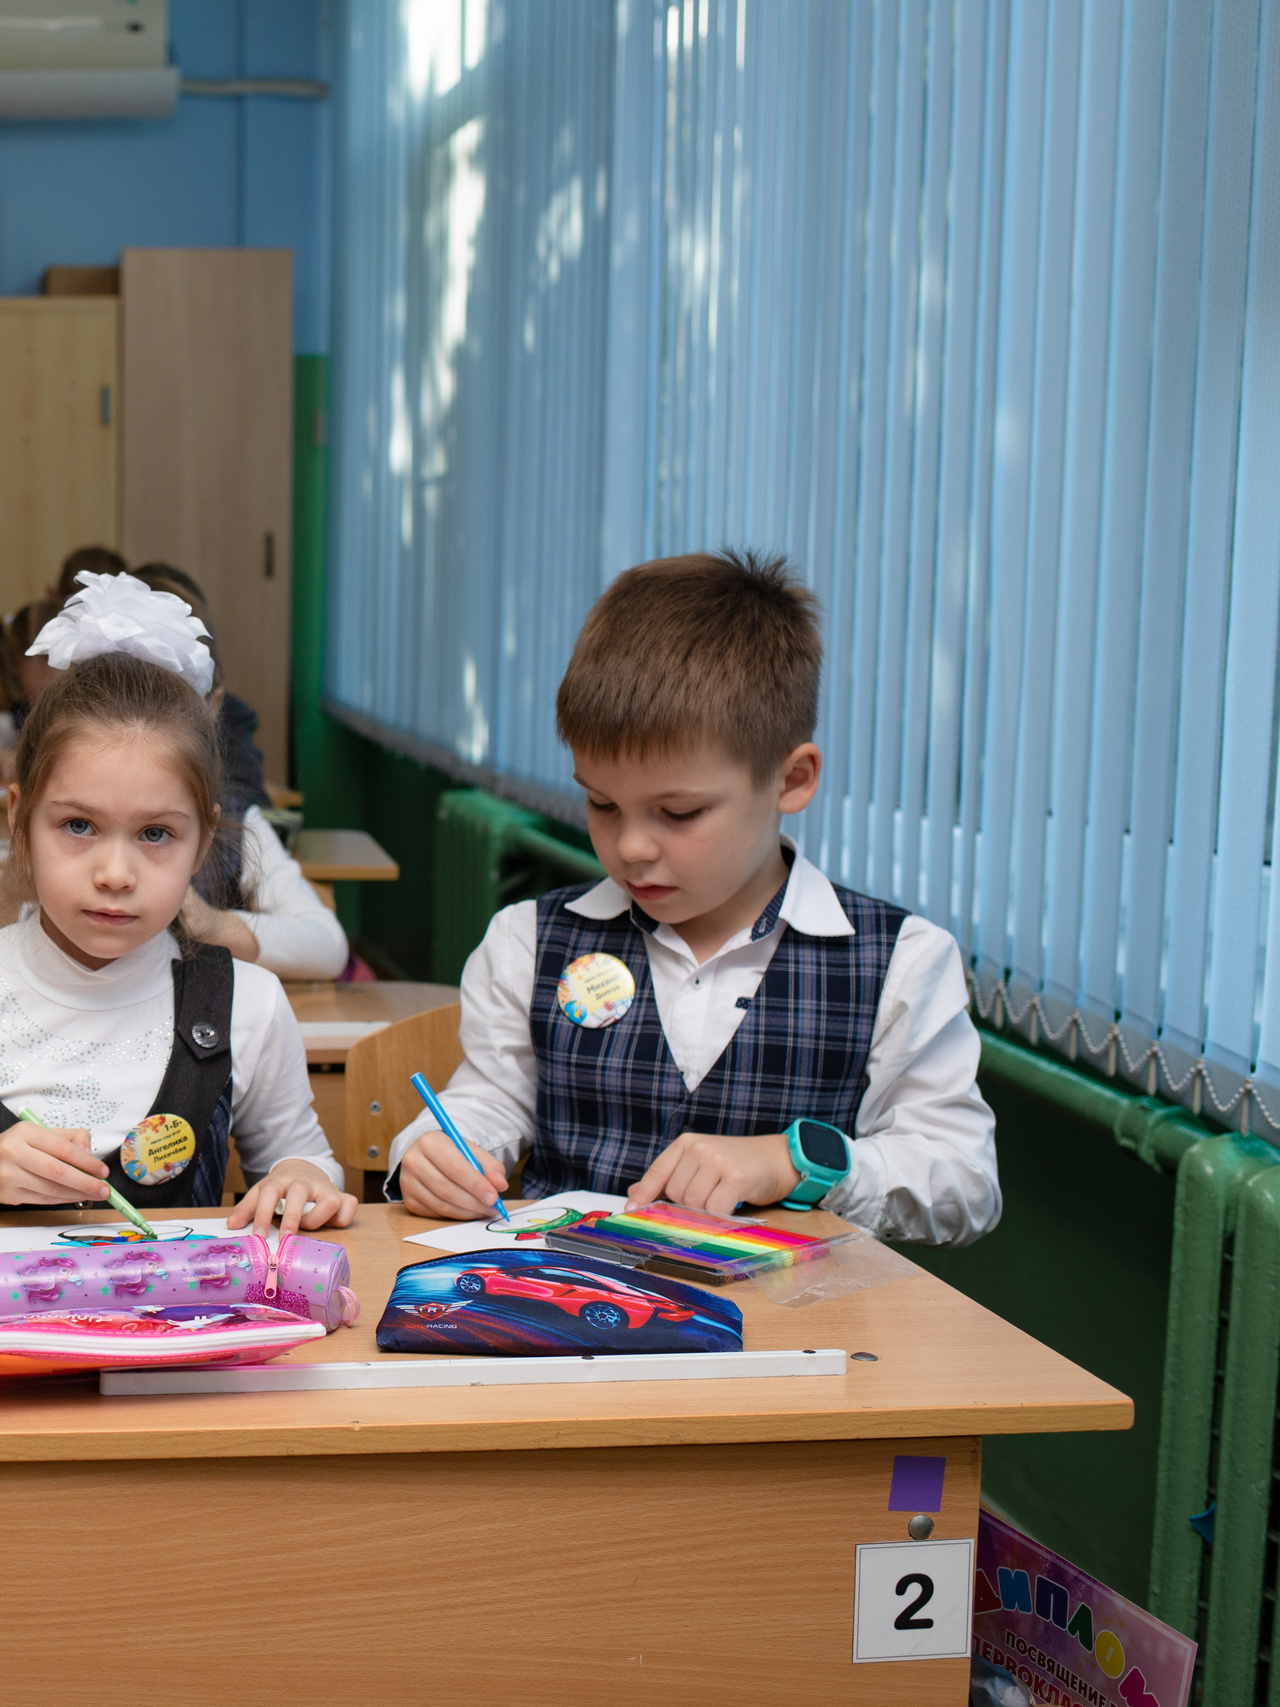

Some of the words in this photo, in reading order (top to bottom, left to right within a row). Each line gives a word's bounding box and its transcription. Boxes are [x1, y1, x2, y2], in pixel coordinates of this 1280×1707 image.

[148, 1136, 188, 1156] Ангелика
[894, 1573, 934, 1630] 2
[1004, 1628, 1109, 1707] ПОСВЯЩЕНИЕ
